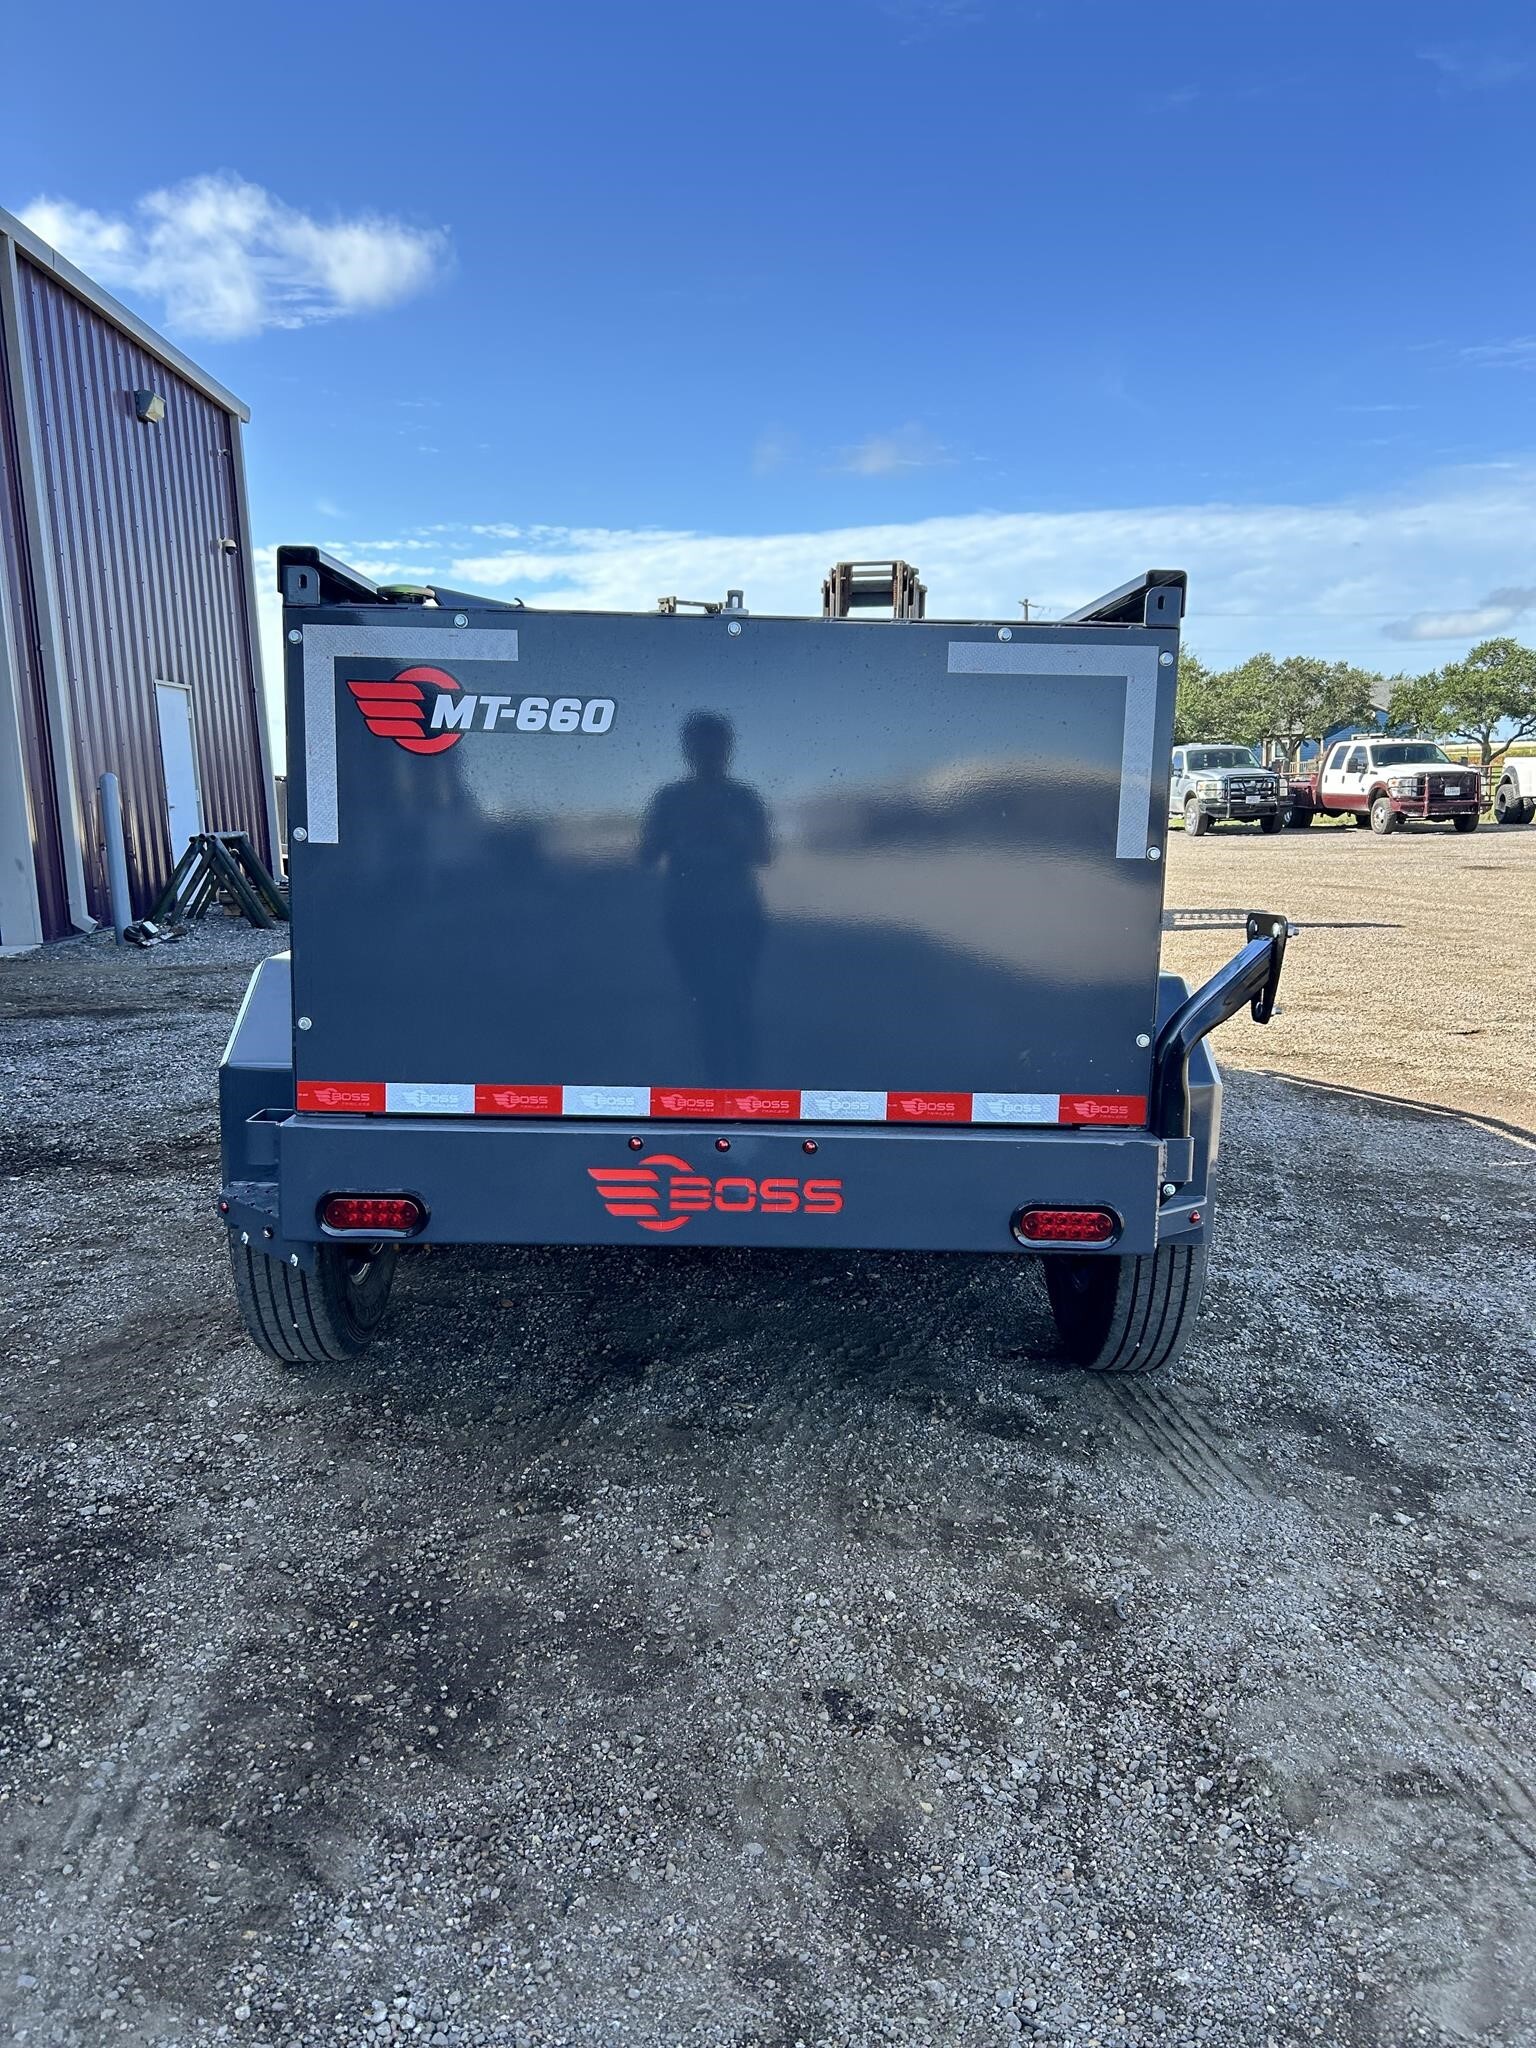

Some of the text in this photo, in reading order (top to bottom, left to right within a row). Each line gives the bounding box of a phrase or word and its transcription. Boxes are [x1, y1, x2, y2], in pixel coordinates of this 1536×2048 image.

[430, 694, 616, 733] MT-660
[331, 1092, 370, 1101] BOSS
[510, 1095, 548, 1104] BOSS
[677, 1098, 715, 1107] BOSS
[752, 1100, 790, 1109] BOSS
[917, 1102, 955, 1111] BOSS
[1090, 1105, 1128, 1114] BOSS
[669, 1176, 844, 1214] BOSS
